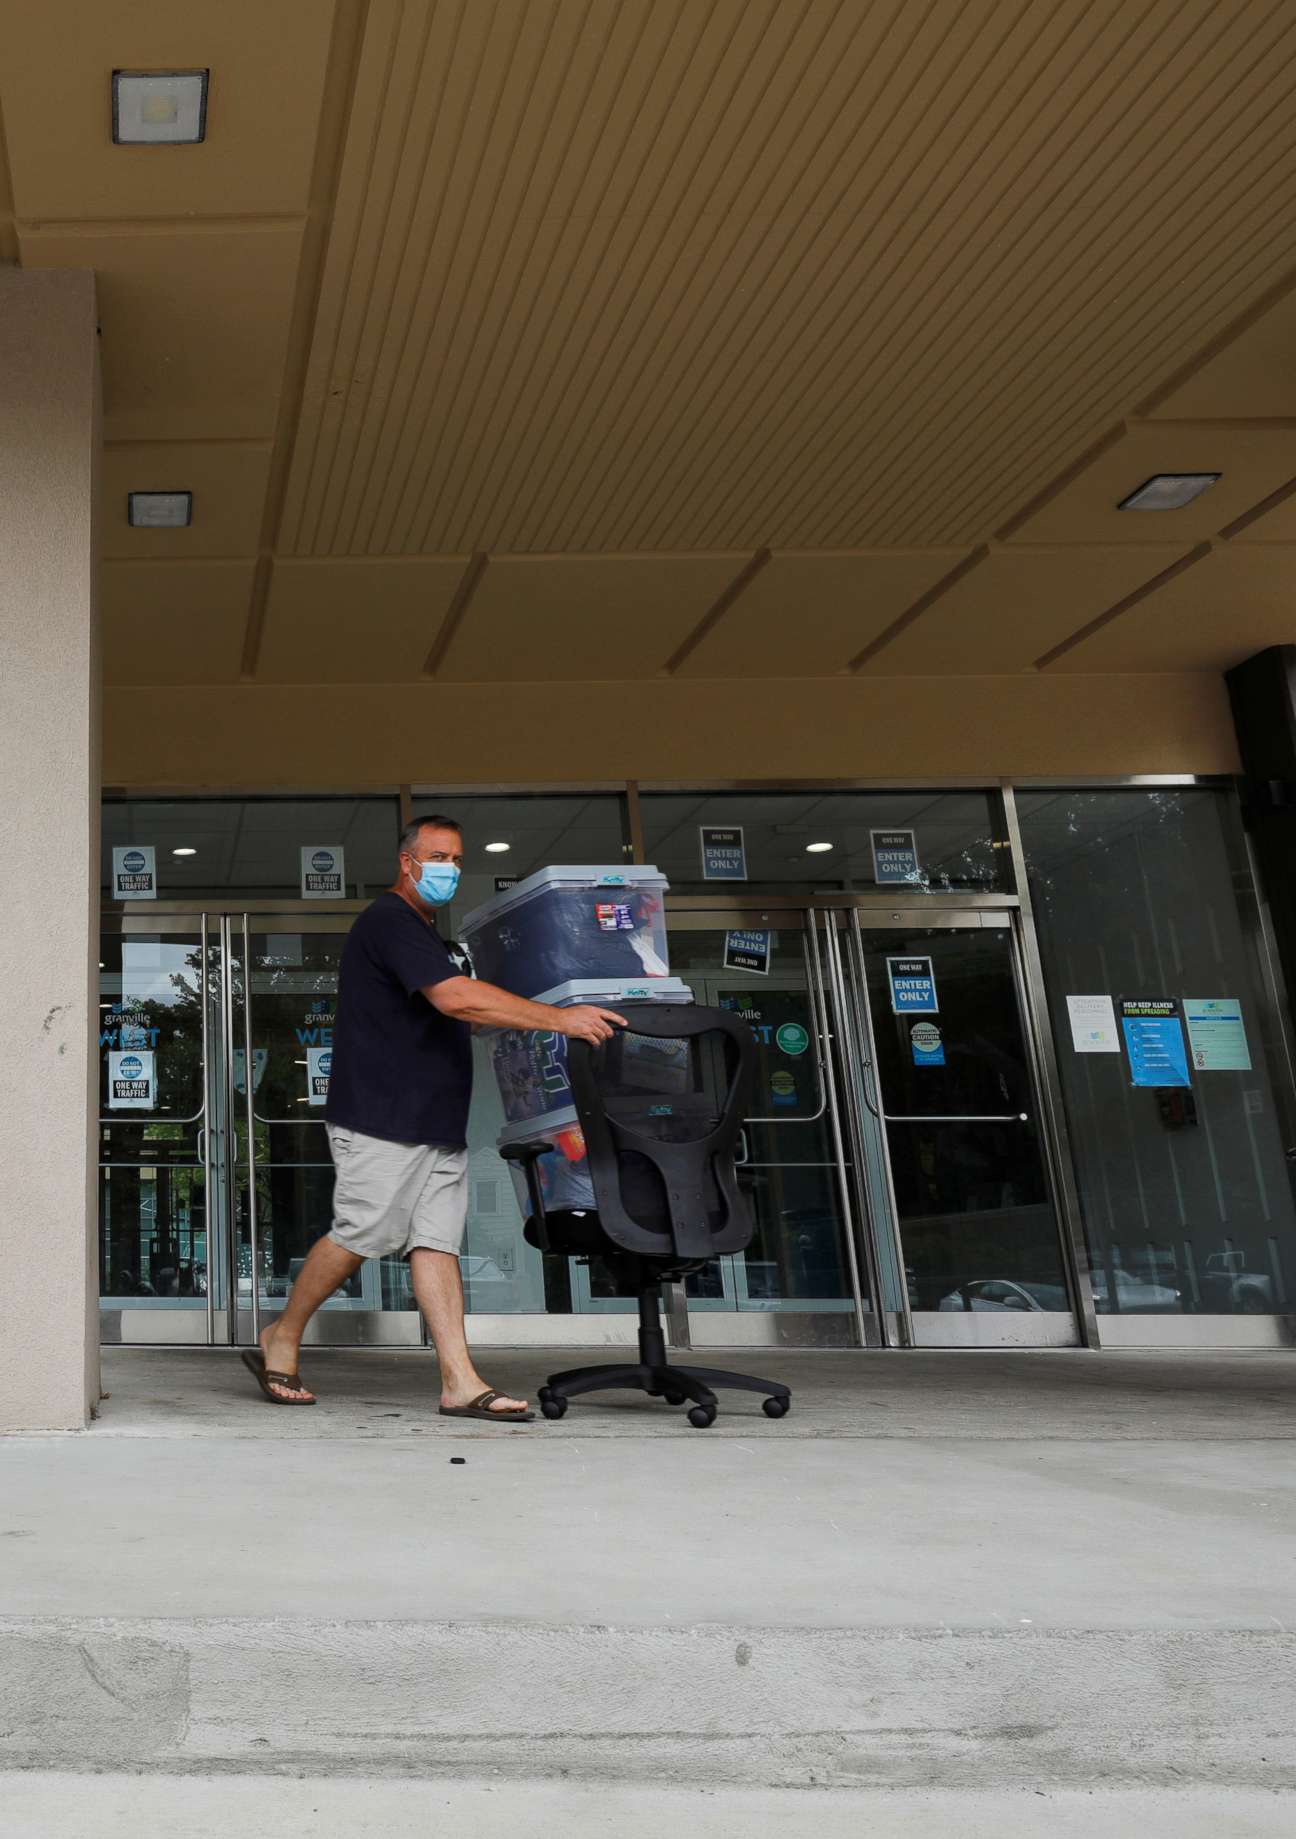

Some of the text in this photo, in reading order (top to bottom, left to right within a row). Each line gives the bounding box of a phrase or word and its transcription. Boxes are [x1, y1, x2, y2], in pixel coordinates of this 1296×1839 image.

[706, 849, 741, 858] ENTER
[878, 853, 913, 861] ENTER
[710, 860, 740, 869] ONLY
[882, 864, 911, 873] ONLY
[135, 874, 150, 882] WAY
[121, 882, 148, 890] TRAFFIC
[310, 882, 338, 890] TRAFFIC
[729, 939, 766, 953] ENTER
[895, 980, 931, 989] ENTER
[899, 992, 930, 1001] ONLY
[104, 1012, 151, 1026] granville
[735, 1009, 761, 1020] ville
[116, 1081, 147, 1089] ONE WAY
[117, 1090, 146, 1098] TRAFFIC
